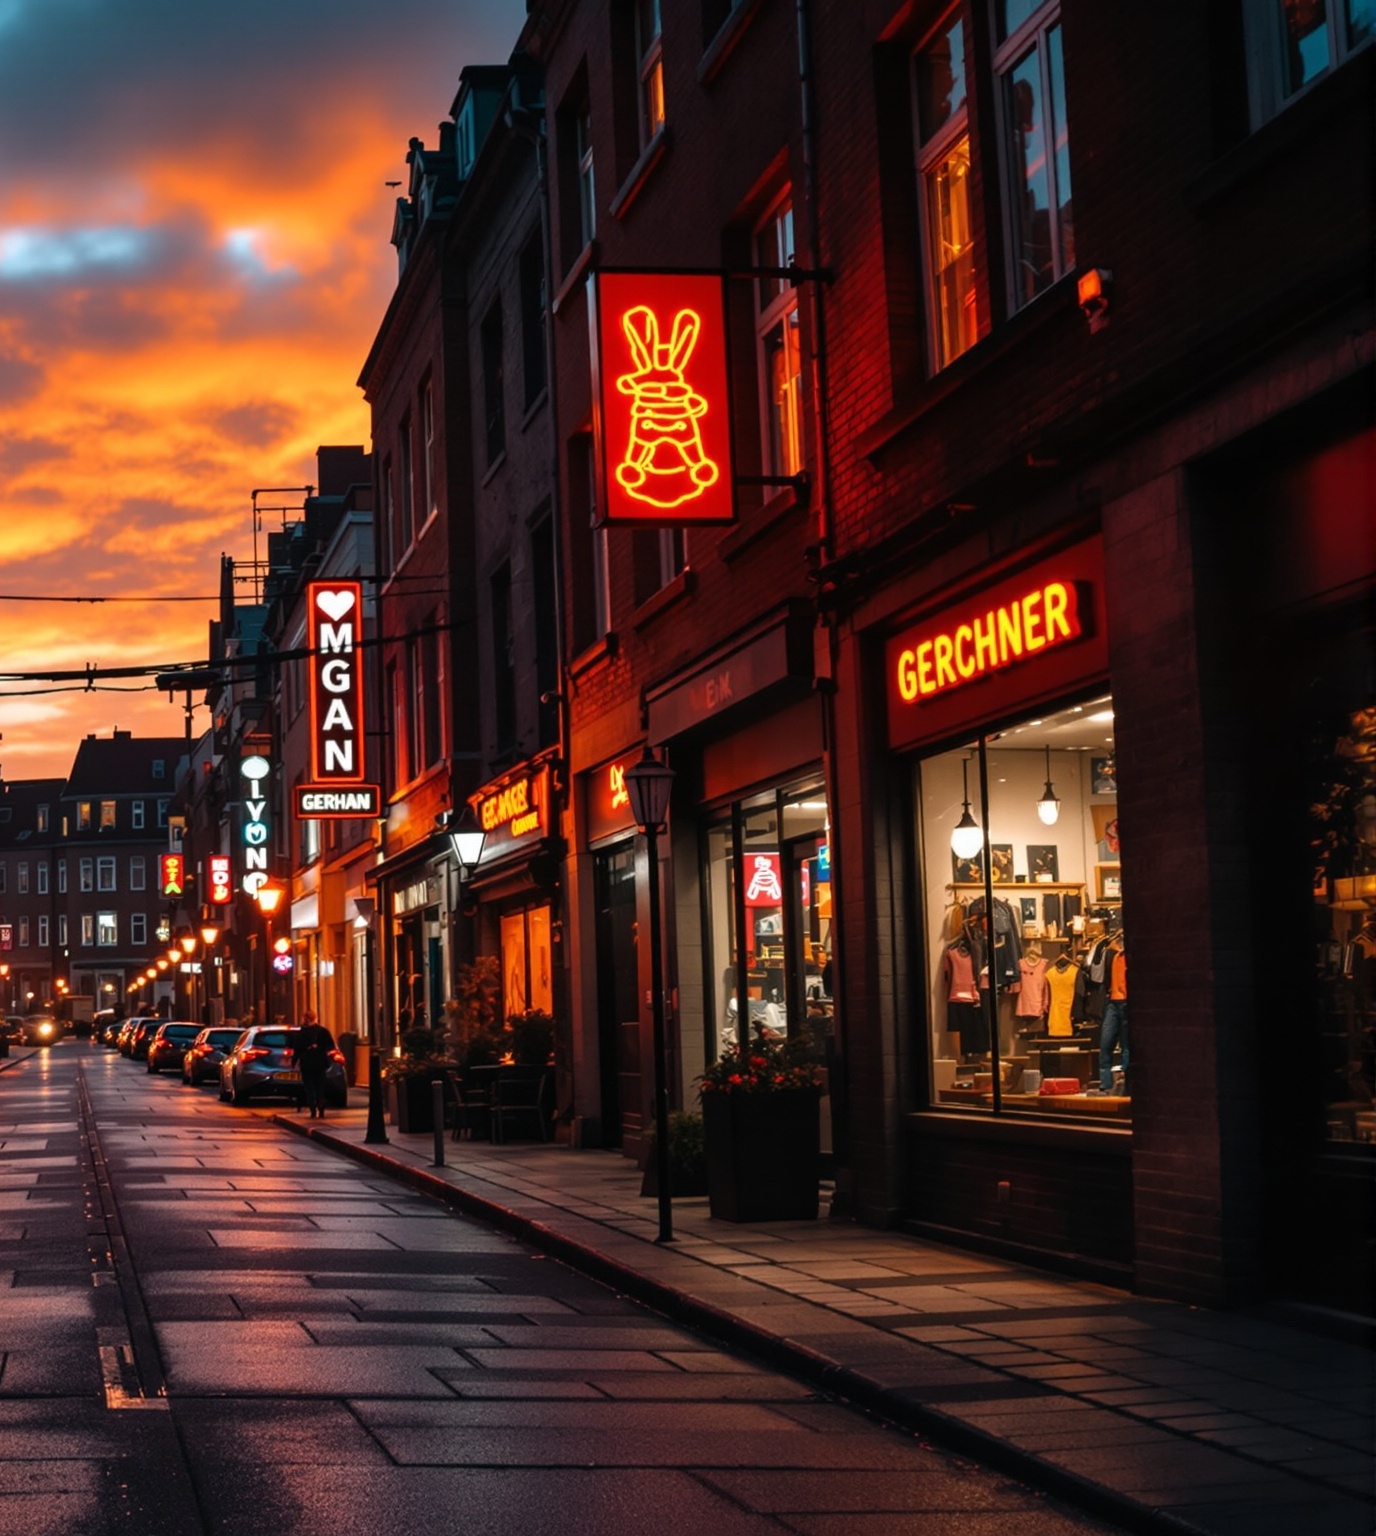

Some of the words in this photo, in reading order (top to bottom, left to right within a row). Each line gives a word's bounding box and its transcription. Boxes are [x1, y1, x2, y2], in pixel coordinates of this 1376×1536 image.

[320, 622, 354, 772] MGAN
[897, 582, 1072, 701] GERCHNER
[302, 793, 371, 811] GERHAN
